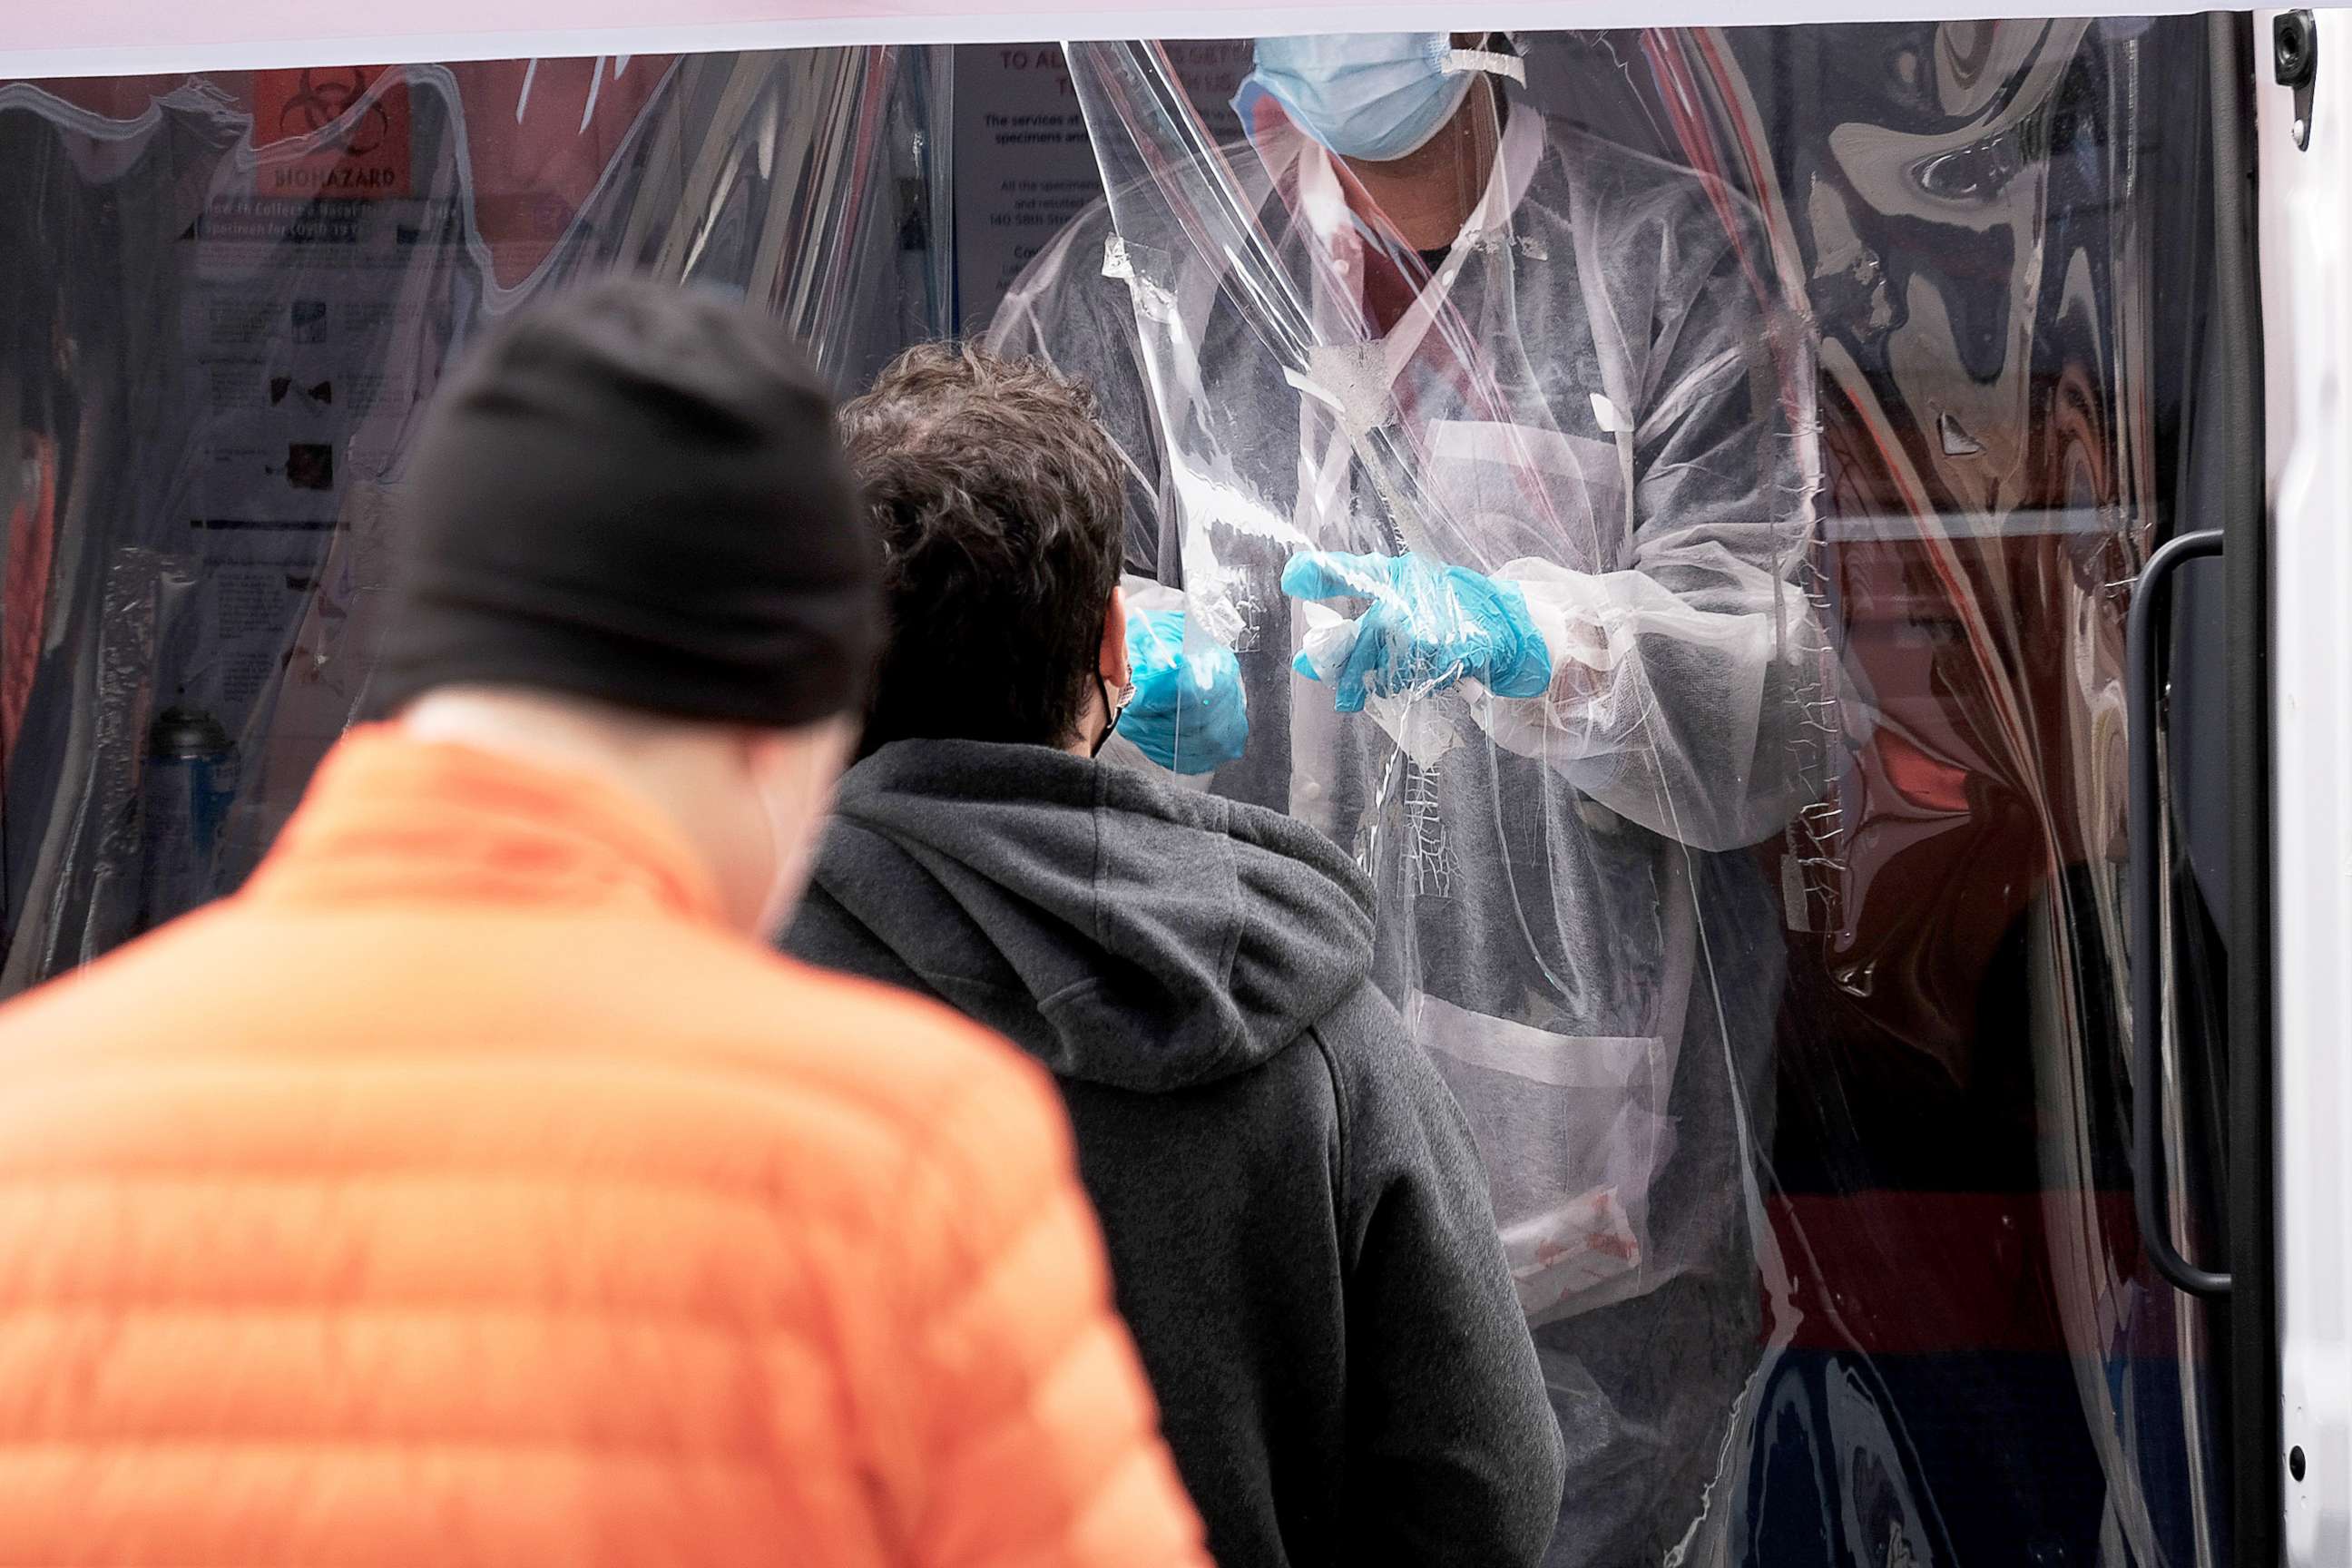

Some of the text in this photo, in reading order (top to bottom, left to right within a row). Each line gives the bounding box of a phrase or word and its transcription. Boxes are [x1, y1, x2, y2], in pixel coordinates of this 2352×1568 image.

[1001, 51, 1027, 70] TO
[985, 113, 1079, 127] The services at
[995, 132, 1062, 145] specimens
[276, 167, 395, 188] BIOHAZARD
[1001, 181, 1015, 191] All
[1018, 181, 1036, 191] the
